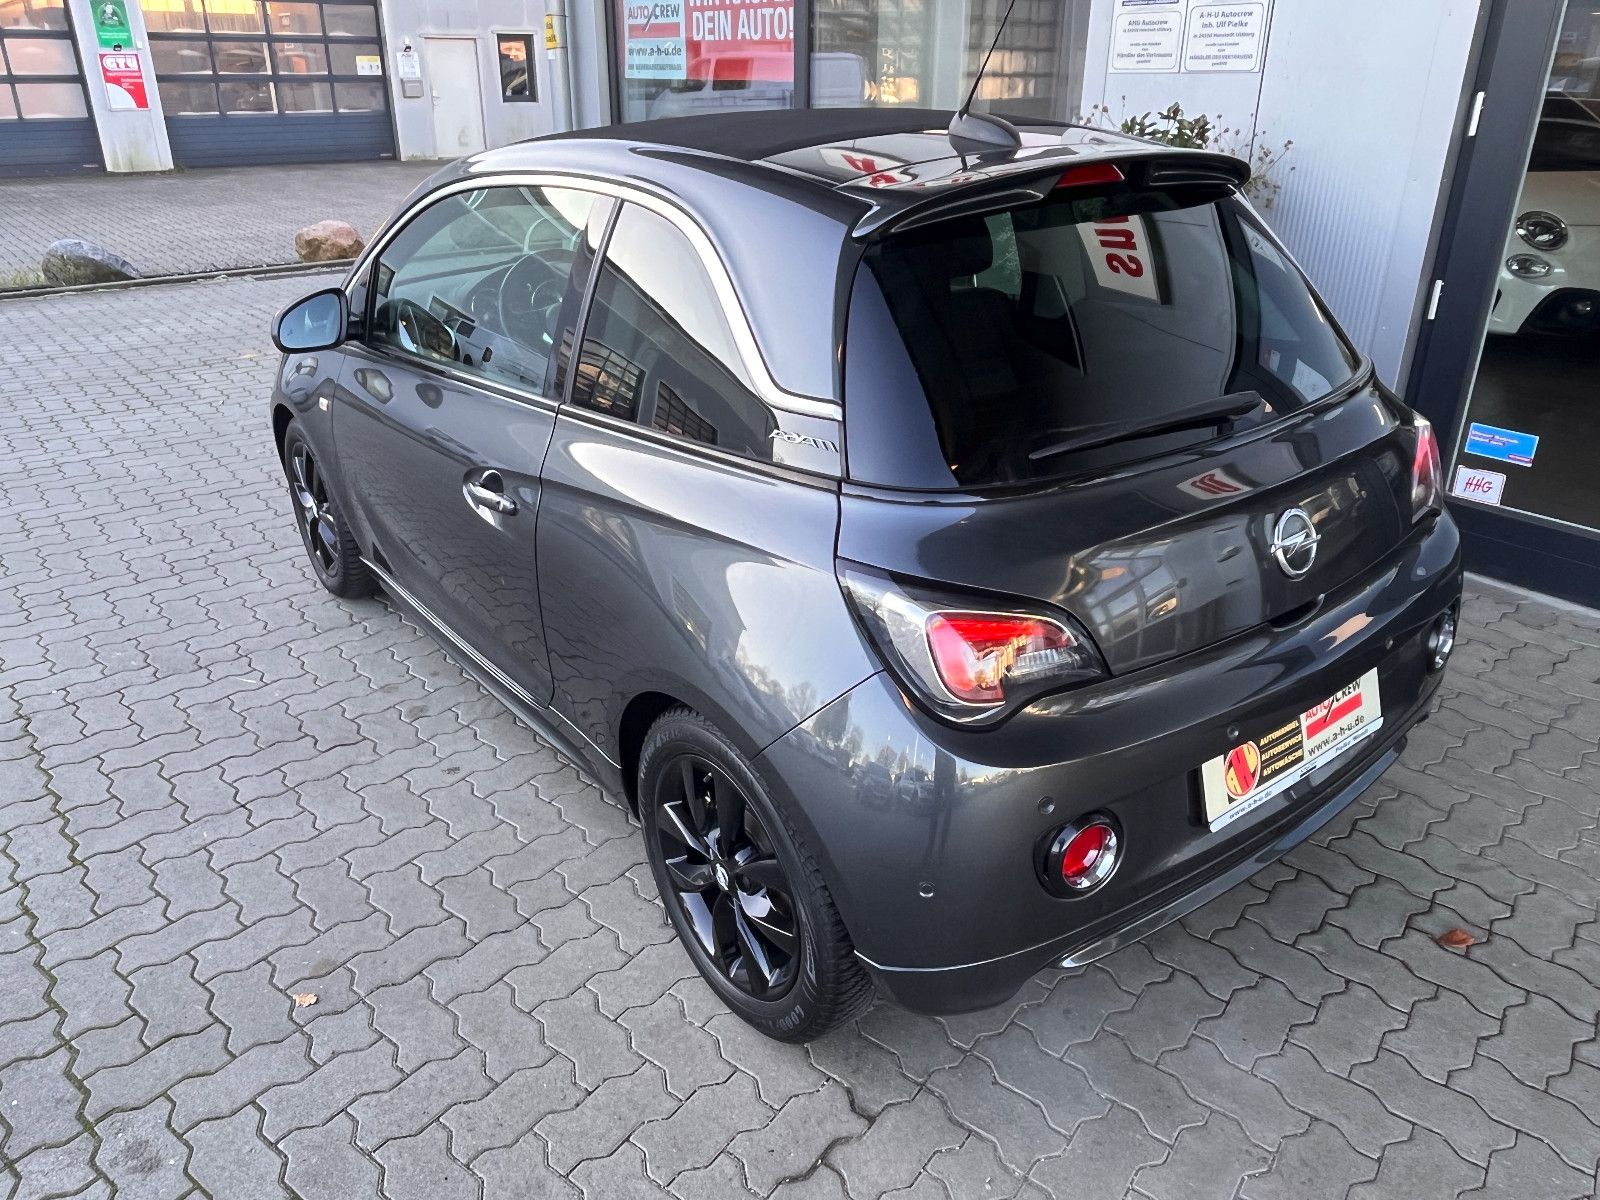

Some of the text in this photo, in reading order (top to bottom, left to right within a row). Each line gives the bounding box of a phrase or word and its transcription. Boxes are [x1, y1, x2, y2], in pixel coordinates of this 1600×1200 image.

[1221, 10, 1254, 18] Autocrew
[692, 6, 794, 41] DEIN AUTO!
[1228, 20, 1249, 28] Pielke
[628, 44, 682, 56] www.a-h-u.de
[1464, 475, 1493, 493] HHG
[1308, 715, 1365, 757] www.a-h-u.de
